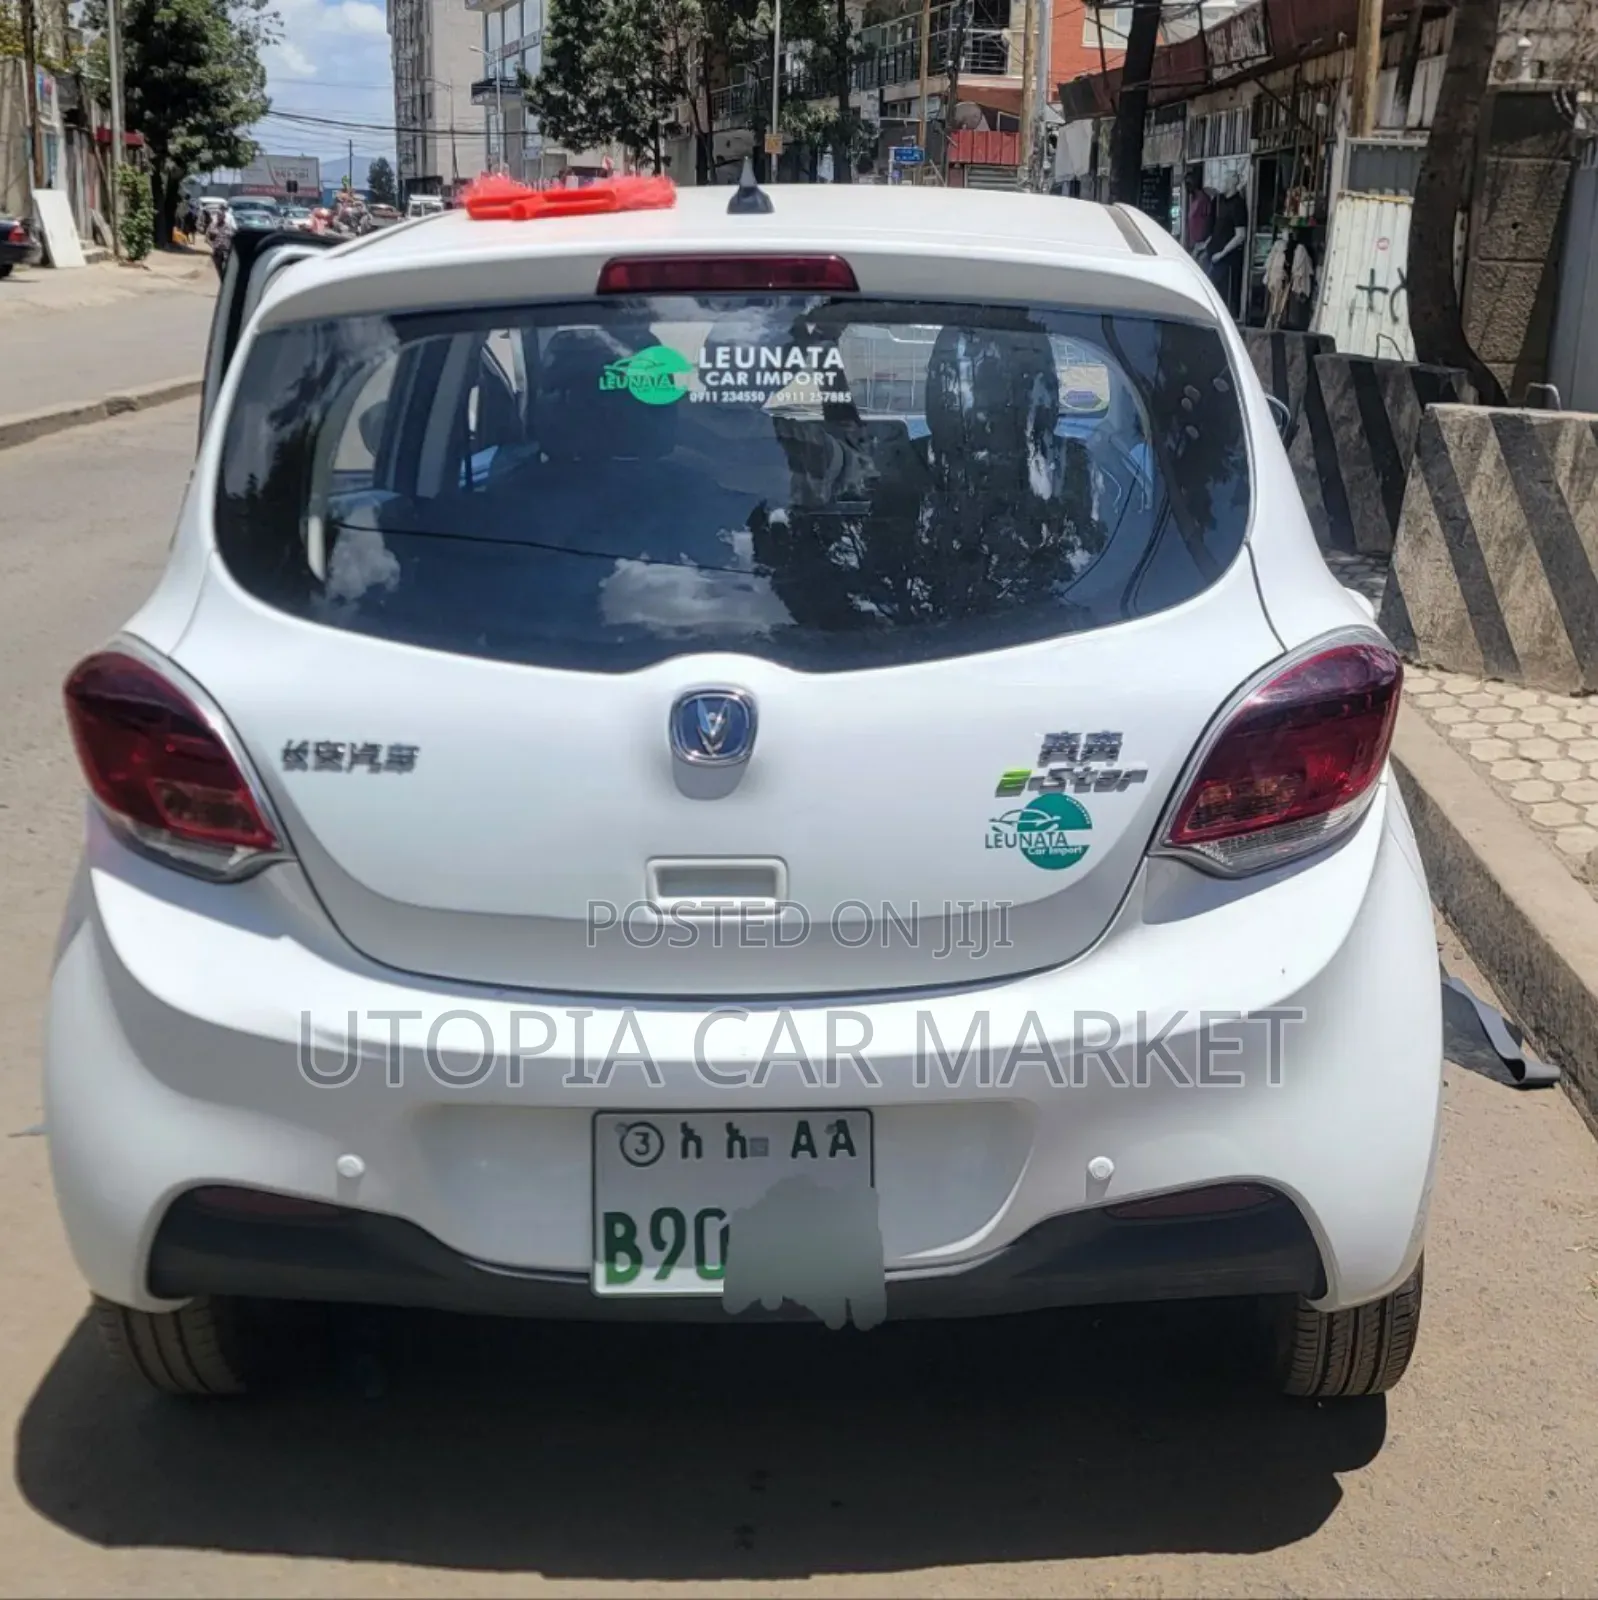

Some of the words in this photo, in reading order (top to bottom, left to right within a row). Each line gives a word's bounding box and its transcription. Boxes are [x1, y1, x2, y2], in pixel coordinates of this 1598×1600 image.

[699, 346, 844, 369] LEUNATA
[598, 373, 672, 390] LEUNATA
[705, 371, 749, 386] CAR
[755, 371, 838, 386] IMPORT
[689, 390, 718, 403] 0911
[721, 390, 766, 403] 234550
[776, 390, 805, 403] 0911
[985, 832, 1068, 849] LEUNATA
[1028, 846, 1046, 856] Car
